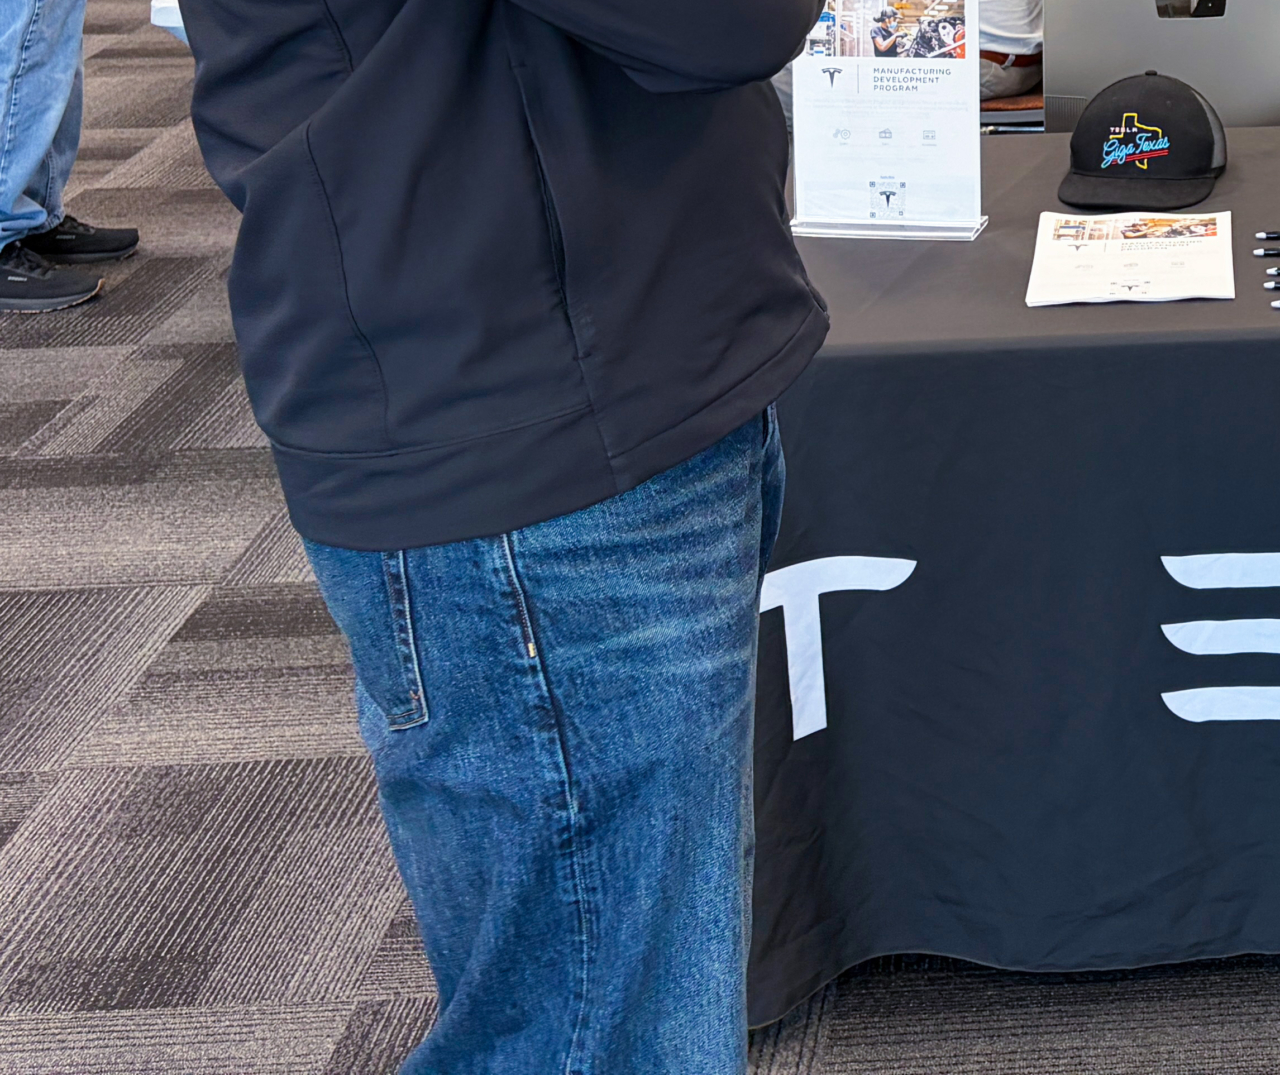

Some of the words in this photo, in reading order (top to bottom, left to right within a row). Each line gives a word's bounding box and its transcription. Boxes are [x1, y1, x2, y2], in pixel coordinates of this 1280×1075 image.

[873, 67, 952, 76] MANUFACTURING
[873, 76, 940, 84] DEVELOPMENT
[873, 84, 918, 92] PROGRAM
[1101, 139, 1135, 168] Giga
[1136, 133, 1170, 154] Texas
